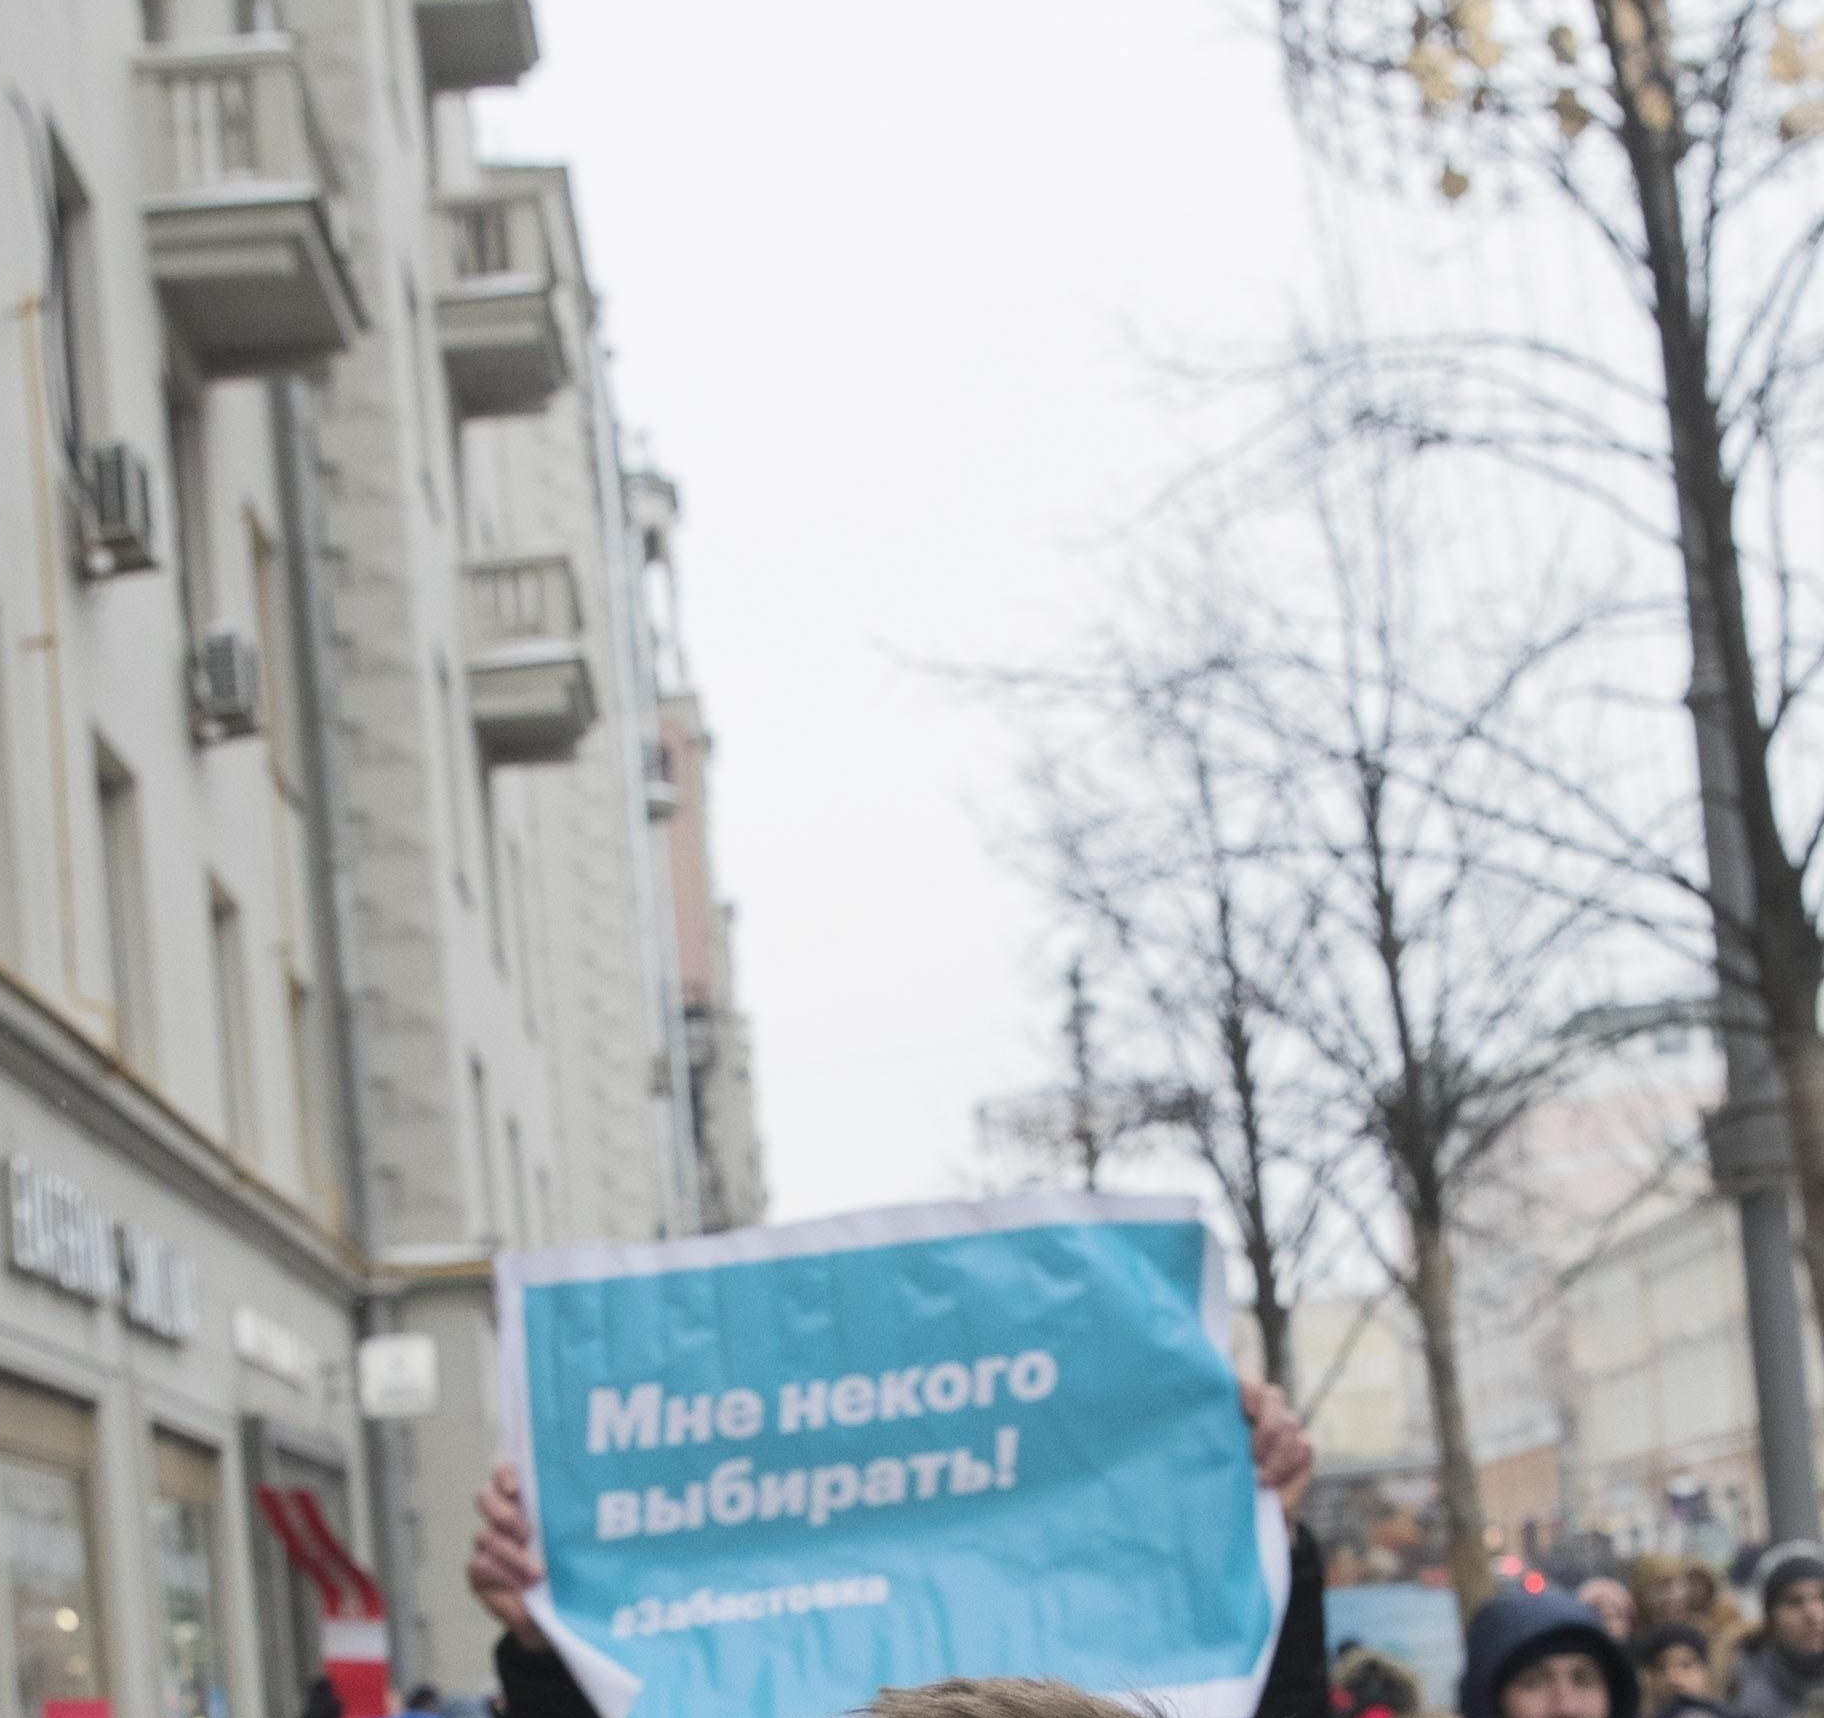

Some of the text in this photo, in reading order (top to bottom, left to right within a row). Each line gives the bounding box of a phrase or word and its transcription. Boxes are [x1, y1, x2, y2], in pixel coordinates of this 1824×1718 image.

[587, 1350, 1058, 1454] Мне некого
[597, 1427, 1021, 1541] выбирать!
